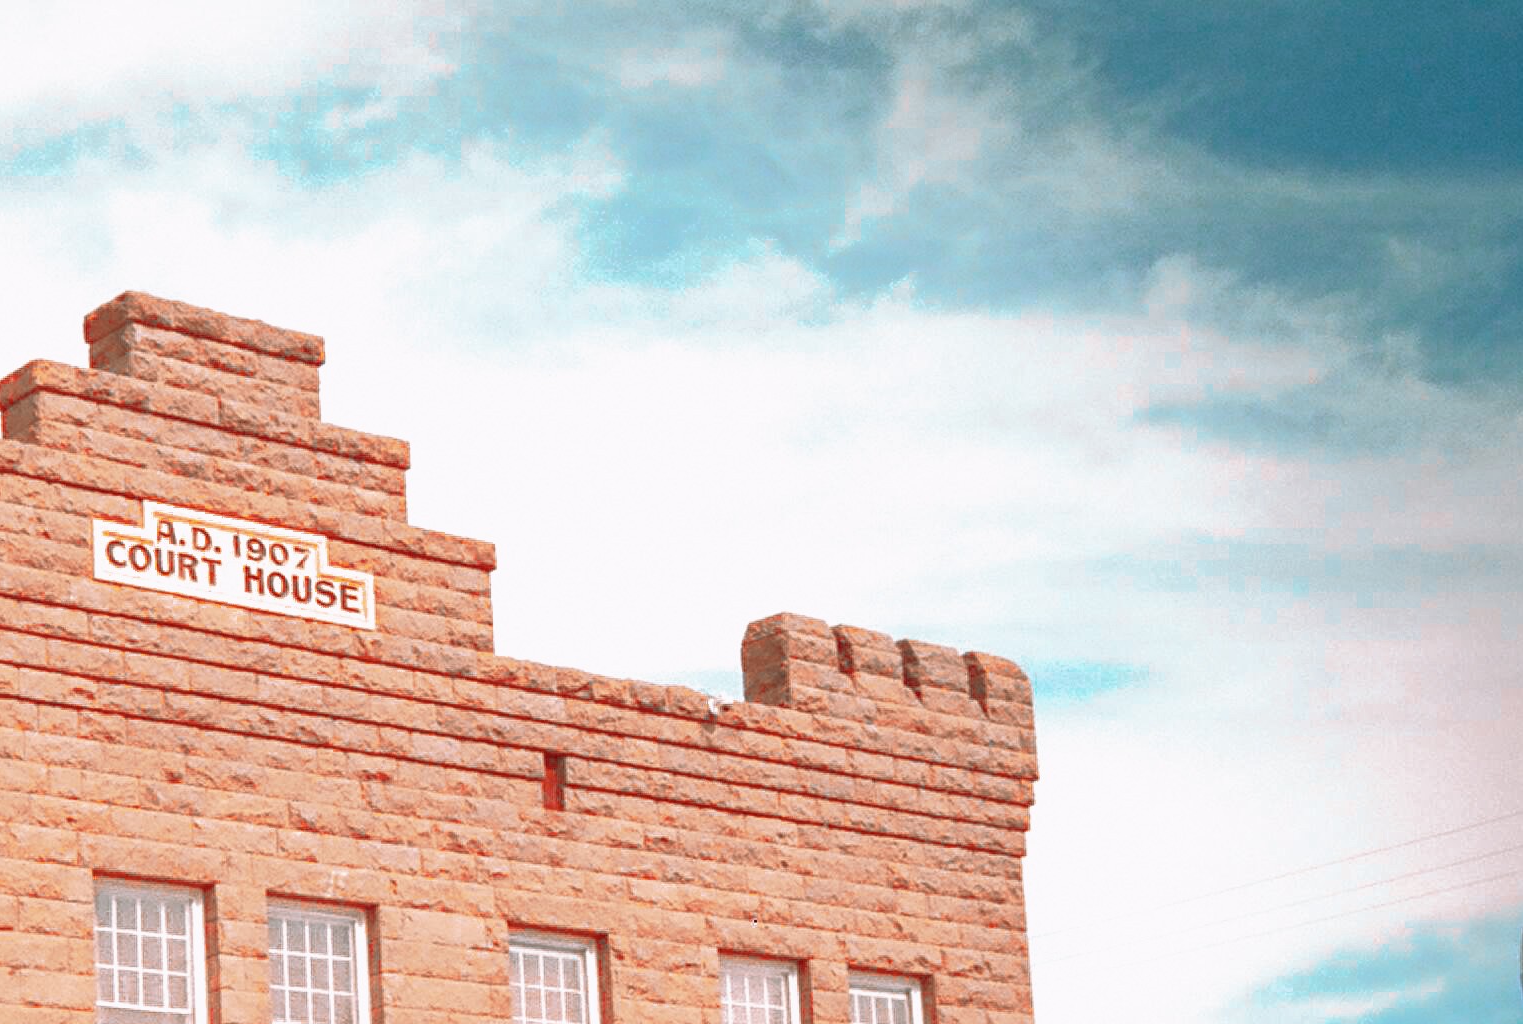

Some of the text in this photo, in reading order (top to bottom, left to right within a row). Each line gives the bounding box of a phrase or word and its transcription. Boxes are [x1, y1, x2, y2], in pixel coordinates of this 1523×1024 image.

[157, 520, 310, 570] A.D. 1907
[105, 540, 360, 614] COURT HOUSE
